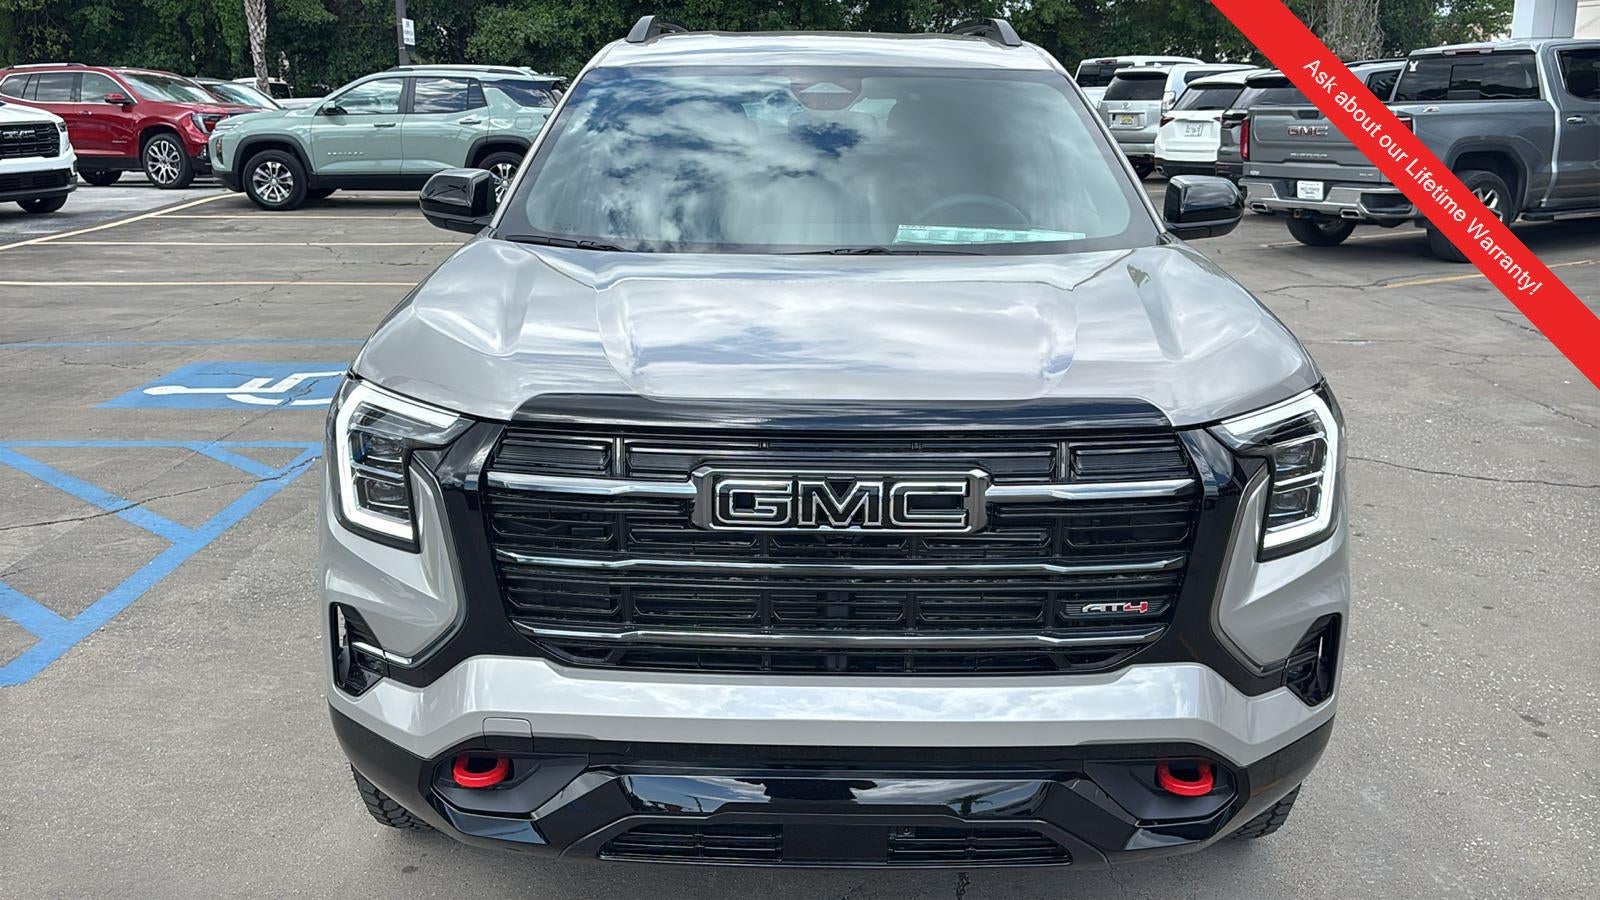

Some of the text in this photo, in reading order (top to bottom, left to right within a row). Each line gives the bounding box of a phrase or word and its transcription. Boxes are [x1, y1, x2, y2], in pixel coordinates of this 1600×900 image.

[1287, 125, 1328, 136] GMC
[714, 479, 967, 527] GMC
[1082, 601, 1149, 614] AT4
